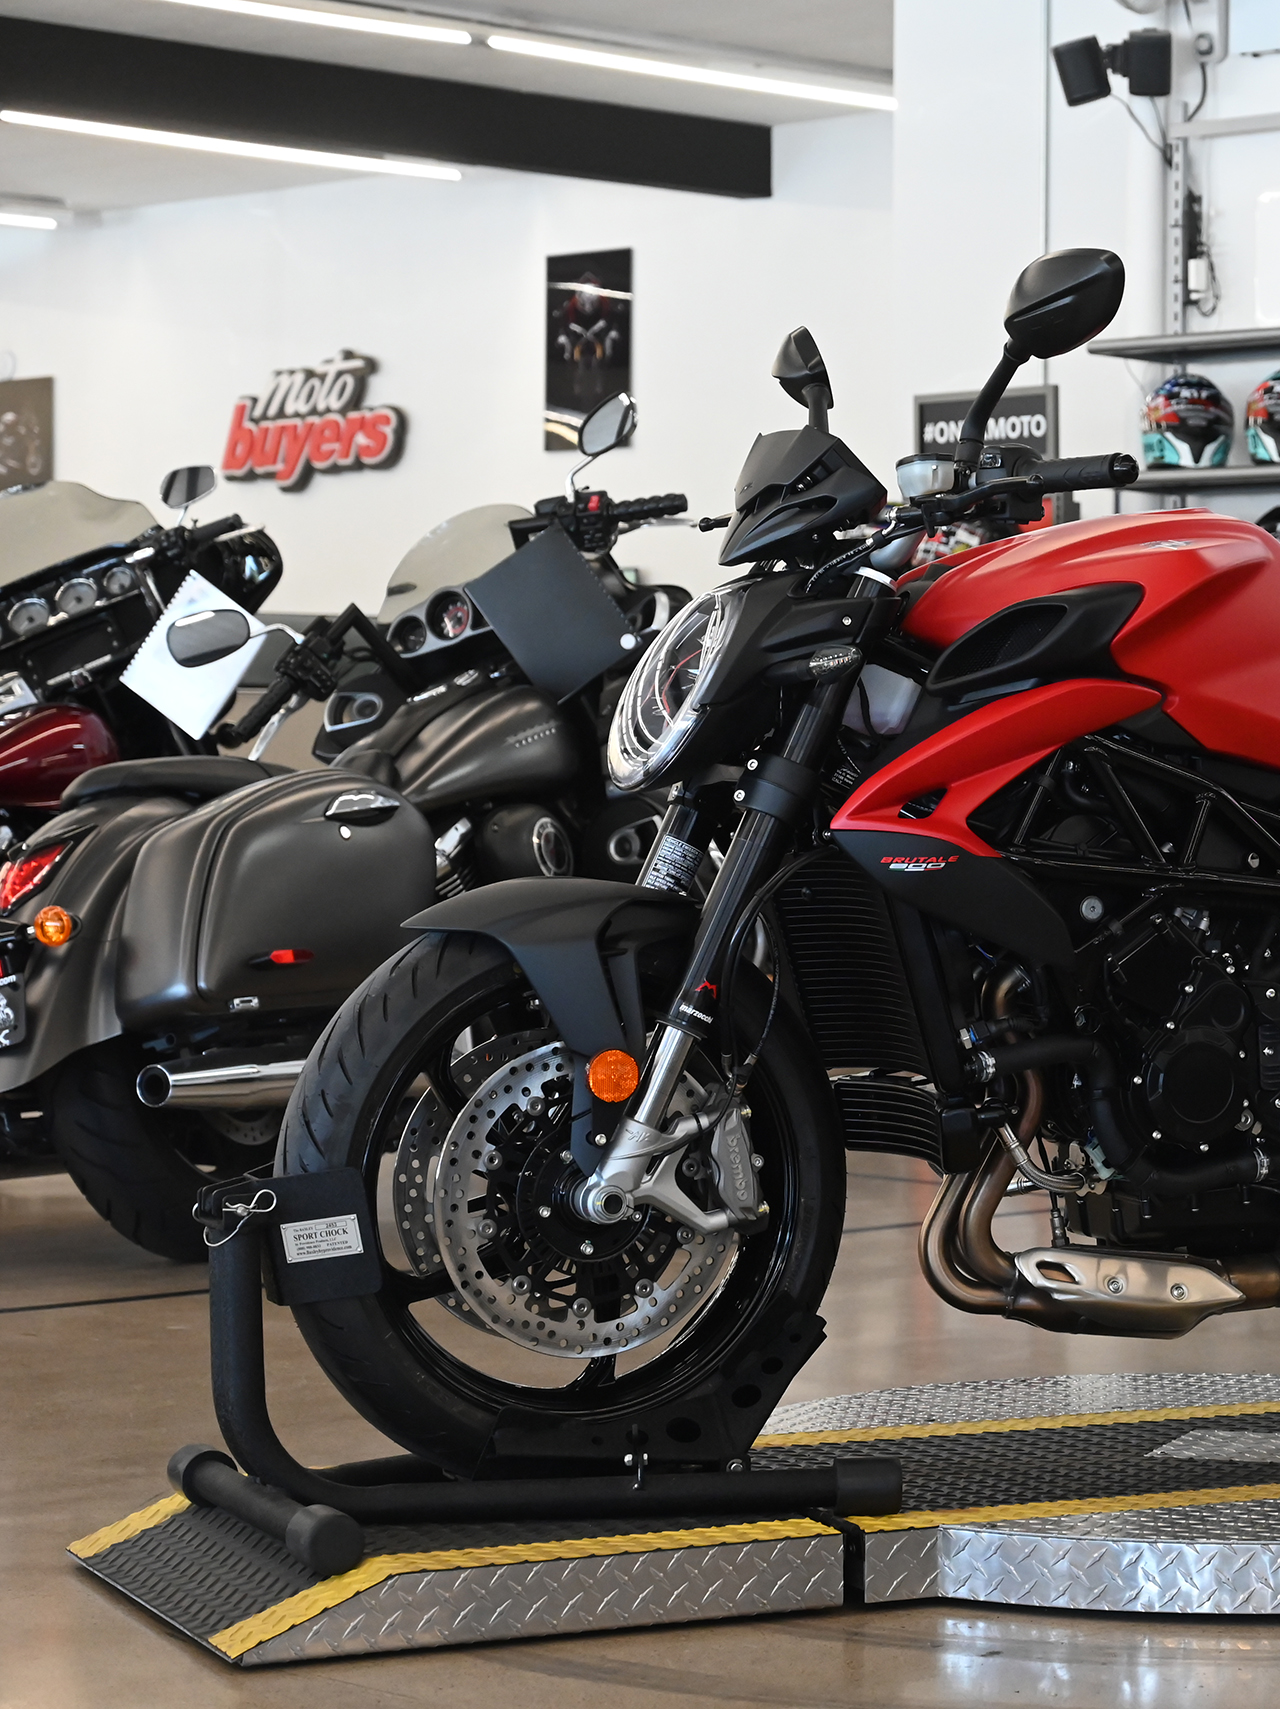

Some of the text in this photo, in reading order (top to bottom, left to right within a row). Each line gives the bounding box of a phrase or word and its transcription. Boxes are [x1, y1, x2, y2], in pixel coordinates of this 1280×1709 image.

[221, 401, 395, 484] buyers
[880, 855, 960, 864] BRUTALE
[679, 1003, 714, 1025] marzocchi
[727, 1134, 748, 1201] brembo
[293, 1228, 349, 1242] SPORT CHOCK
